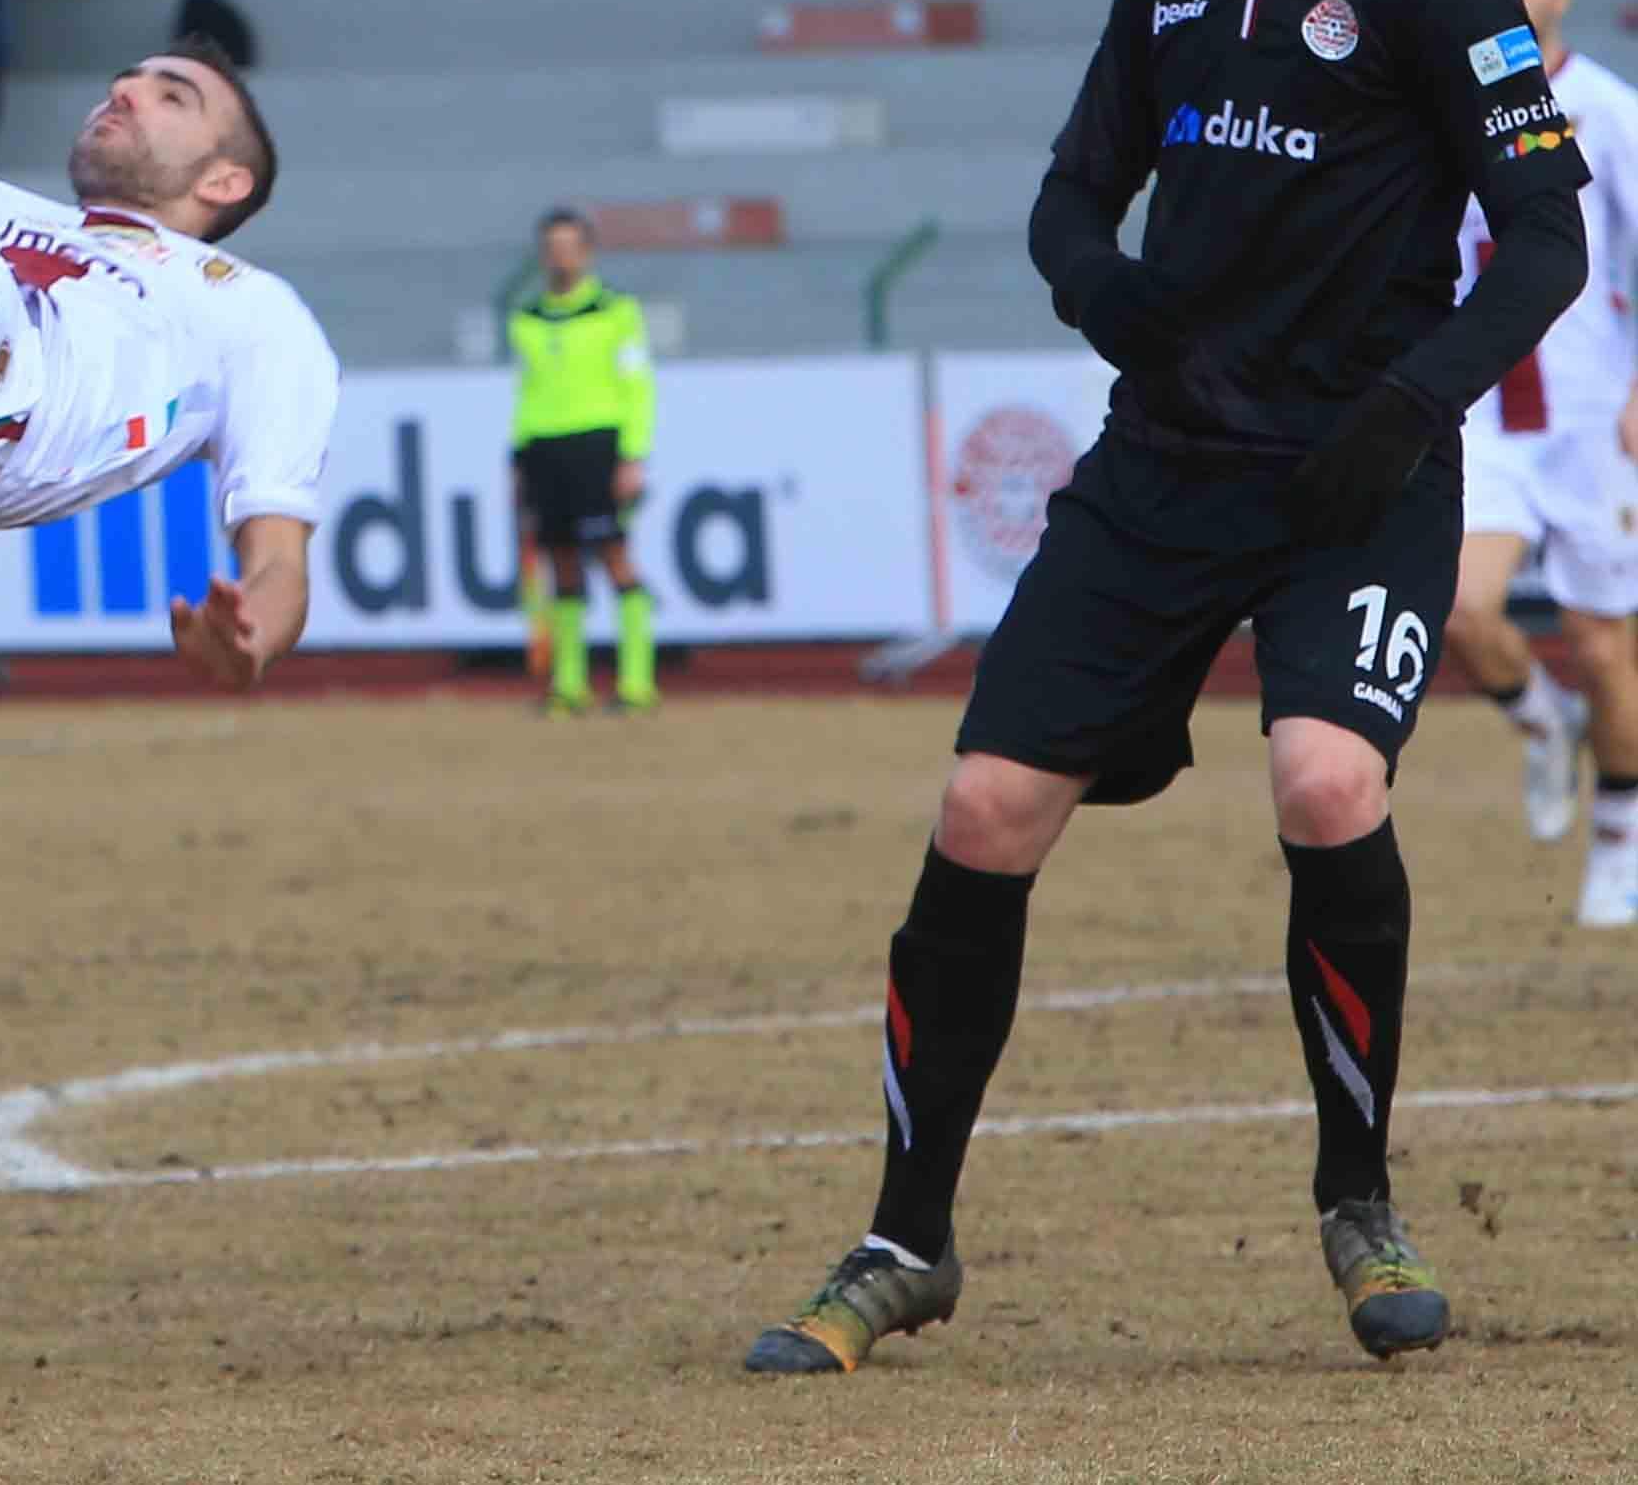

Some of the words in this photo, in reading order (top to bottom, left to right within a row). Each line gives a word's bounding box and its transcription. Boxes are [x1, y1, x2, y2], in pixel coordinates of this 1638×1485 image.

[1204, 99, 1316, 161] duka
[333, 419, 770, 614] dua
[1347, 584, 1429, 702] 16
